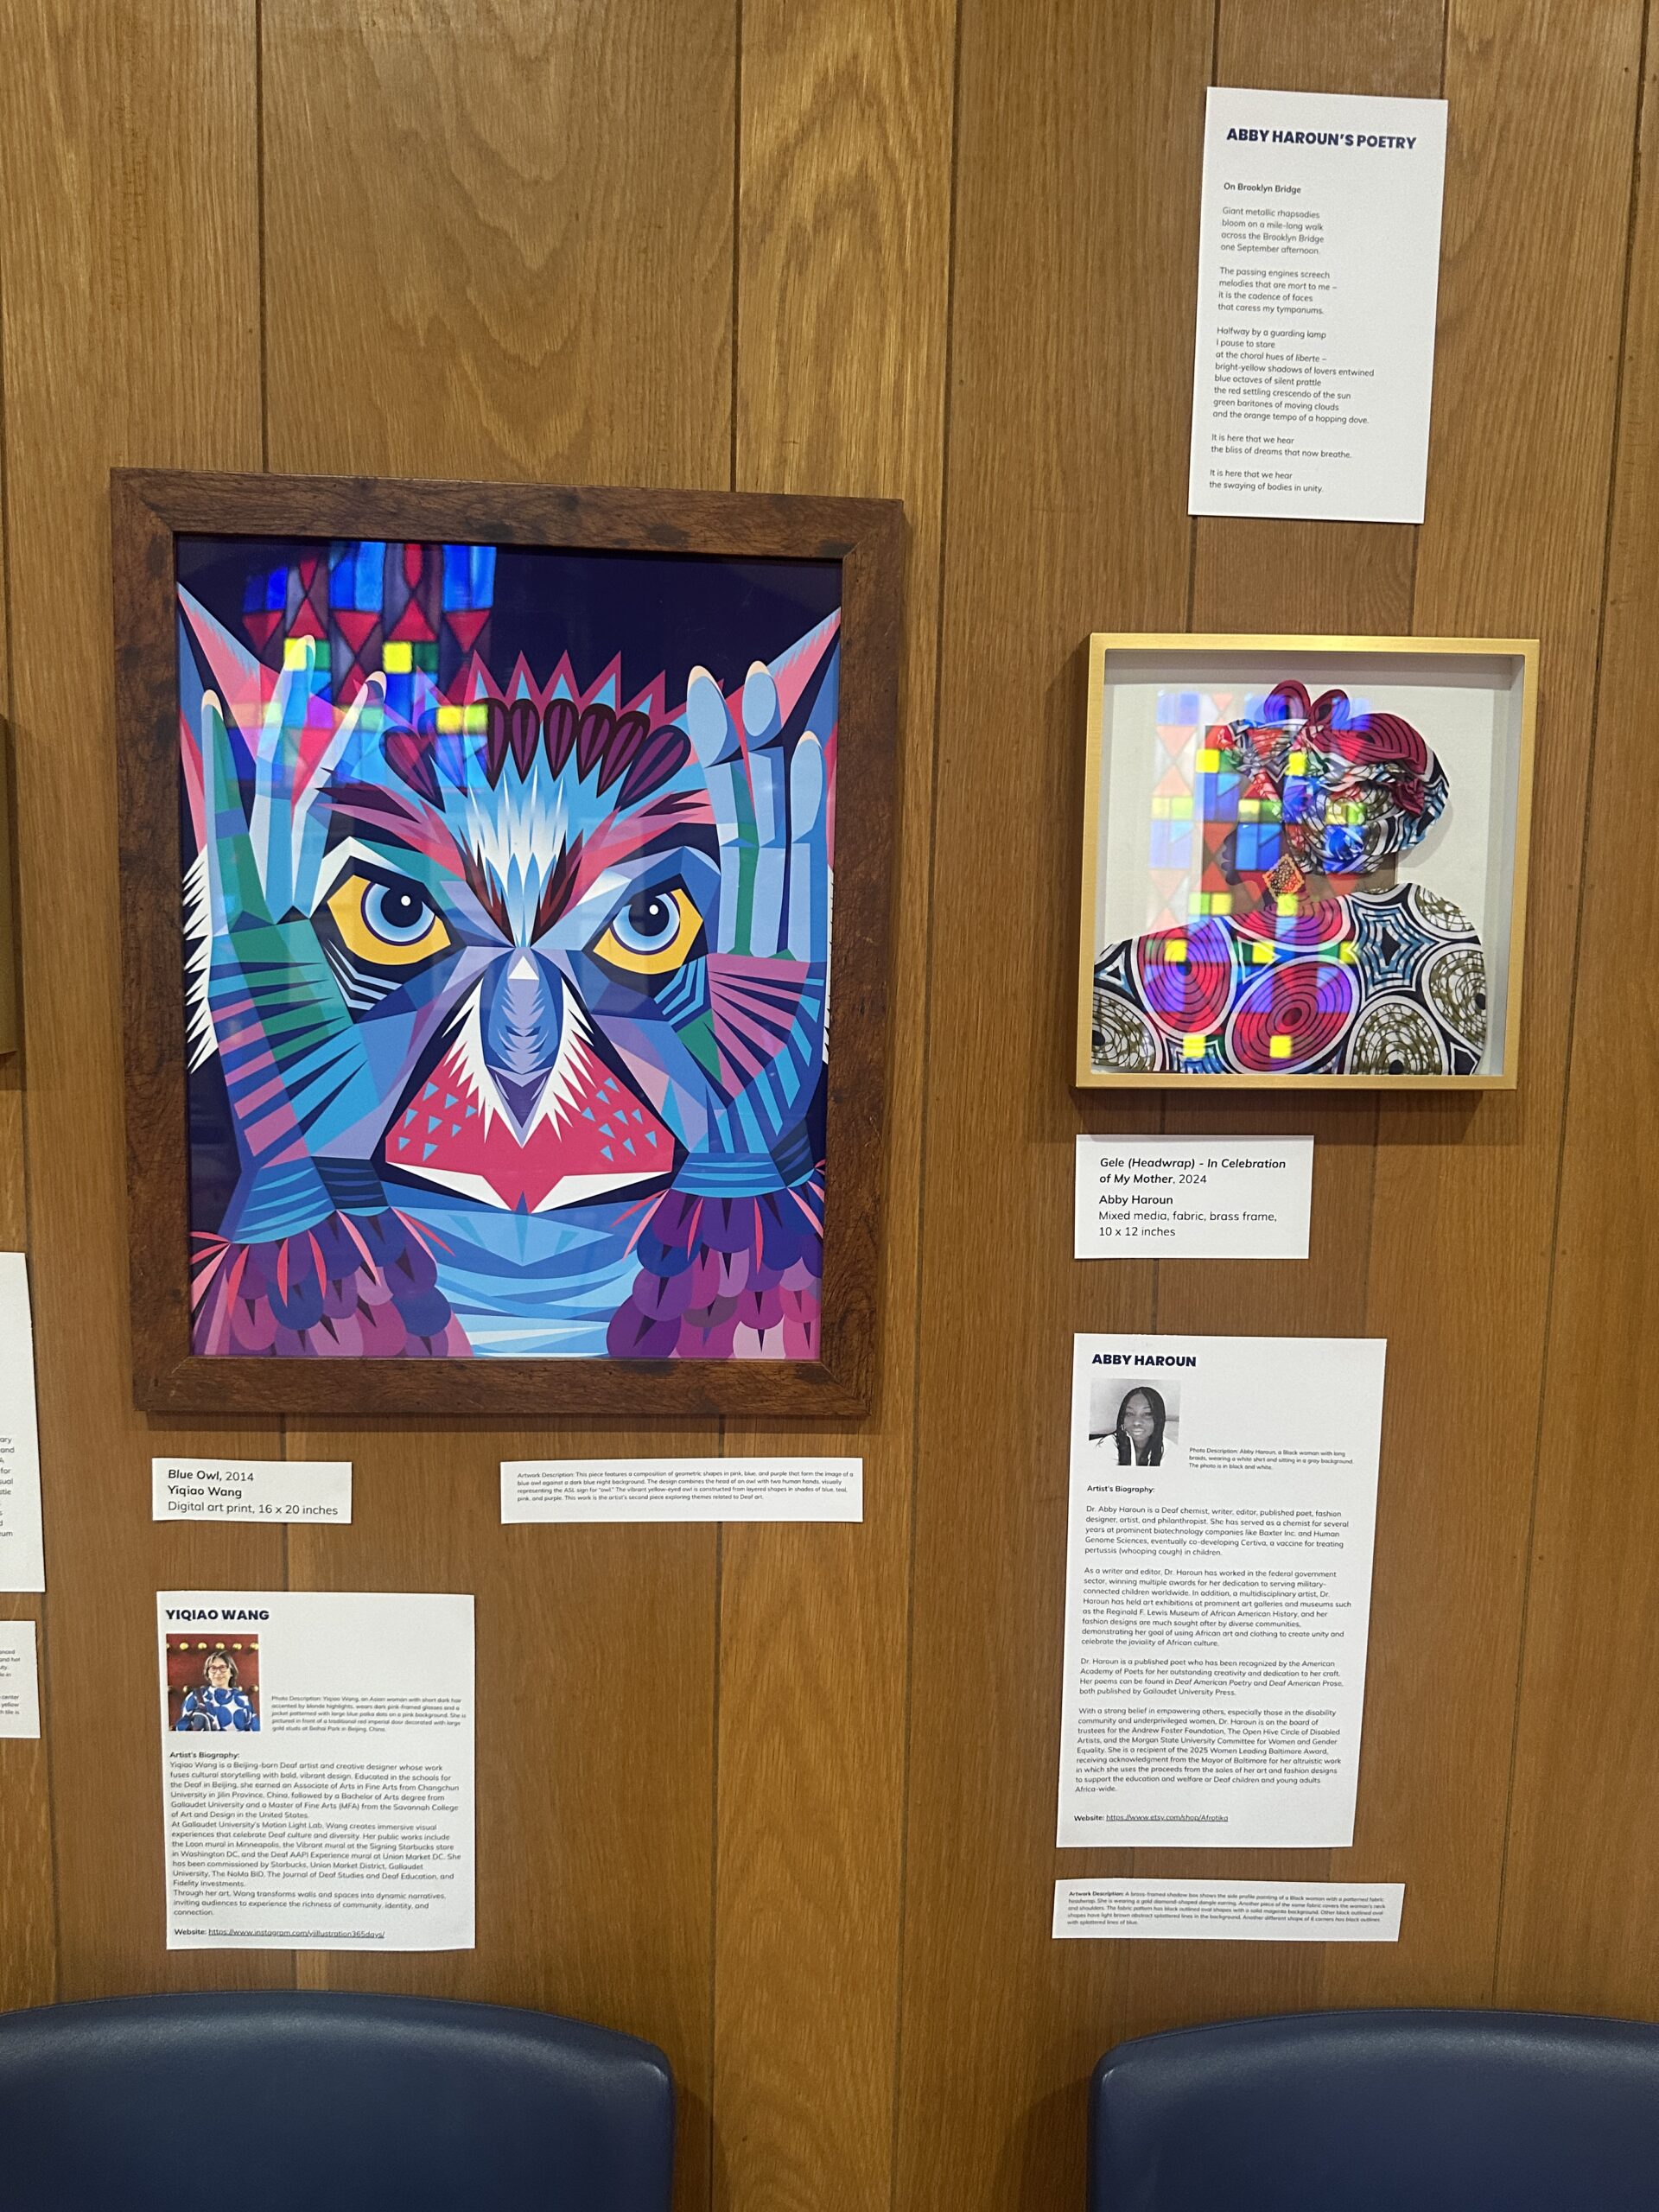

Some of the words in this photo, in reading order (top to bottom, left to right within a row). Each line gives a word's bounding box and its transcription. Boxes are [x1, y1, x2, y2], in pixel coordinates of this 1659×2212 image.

[1226, 128, 1269, 142] ABBY
[1357, 135, 1416, 149] POETRY
[1237, 182, 1273, 194] Brooklyn
[1275, 185, 1301, 195] Bridge
[1222, 207, 1243, 215] Giant
[1245, 208, 1275, 217] metallic
[1277, 209, 1320, 219] rhapsodies
[1222, 219, 1246, 227] bloom
[1267, 221, 1303, 232] mile-long
[1248, 232, 1261, 240] the
[1263, 232, 1297, 243] Brooklyn
[1299, 234, 1325, 245] Bridge
[1219, 266, 1235, 275] The
[1236, 269, 1267, 278] passing
[1268, 270, 1299, 279] engines
[1215, 362, 1266, 372] bright-yellow
[1268, 365, 1302, 374] shadows
[1313, 366, 1337, 375] lovers
[1243, 388, 1271, 397] settling
[1272, 390, 1312, 398] crescendo
[1323, 391, 1335, 399] the
[1243, 412, 1271, 422] orange
[1273, 413, 1297, 423] tempo
[1315, 415, 1347, 425] hopping
[1224, 482, 1255, 492] swaying
[1100, 1158, 1124, 1167] Gele
[1128, 1158, 1195, 1170] (Headwrap)
[1207, 1159, 1217, 1168] In
[1221, 1159, 1286, 1168] Celebration
[1099, 1173, 1111, 1183] of
[1114, 1173, 1130, 1185] My
[1134, 1173, 1175, 1184] Mother,
[1179, 1174, 1206, 1184] 2024
[1098, 1194, 1128, 1206] Abby
[1132, 1195, 1173, 1205] Haroun
[1099, 1211, 1130, 1220] Mixed
[1134, 1211, 1169, 1221] media,
[1173, 1211, 1206, 1222] fabric,
[1210, 1211, 1239, 1221] brass
[1243, 1211, 1277, 1222] frame,
[1099, 1226, 1112, 1236] 10
[1125, 1227, 1138, 1236] 12
[1141, 1227, 1176, 1236] inches
[1091, 1354, 1132, 1365] ABBY
[1135, 1355, 1196, 1367] HAROUN
[168, 1469, 194, 1479] Blue
[196, 1470, 222, 1482] Owl,
[226, 1471, 254, 1481] 2014
[168, 1485, 205, 1497] Yiqiao
[207, 1486, 242, 1499] Wang
[168, 1501, 204, 1513] Digital
[207, 1503, 224, 1512] art
[226, 1503, 255, 1515] print,
[259, 1503, 272, 1514] 16
[285, 1504, 300, 1515] 20
[302, 1505, 338, 1516] inches
[165, 1610, 219, 1621] YIQIAO
[221, 1610, 269, 1620] WANG
[1179, 1688, 1214, 1697] University
[199, 1751, 239, 1760] Biography:
